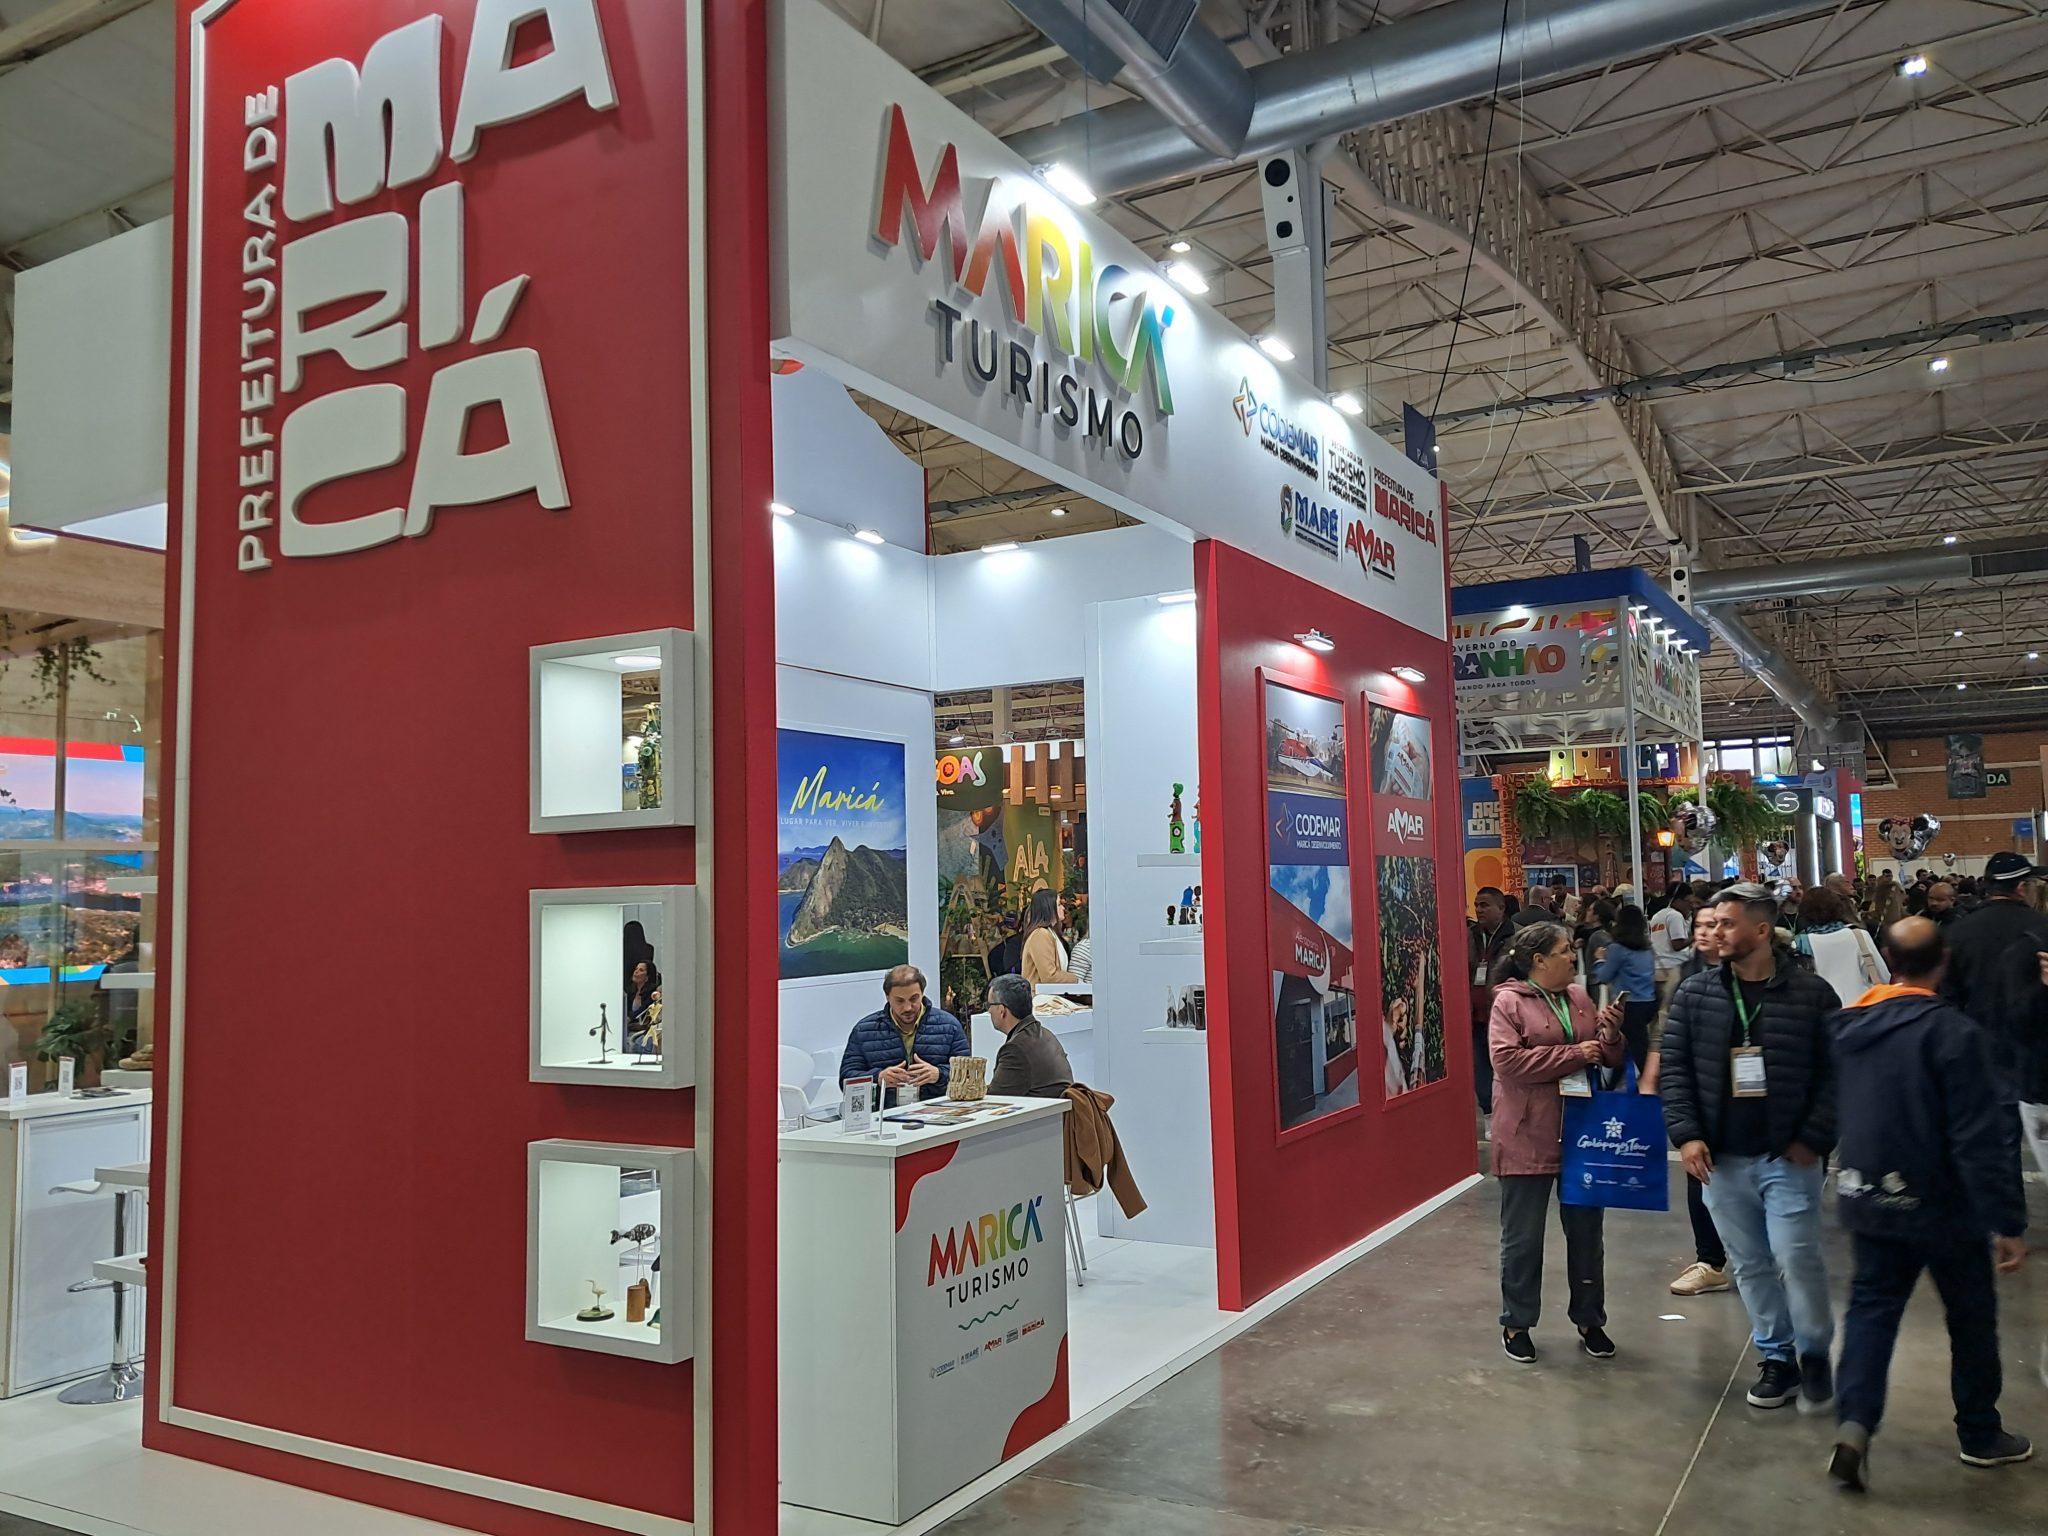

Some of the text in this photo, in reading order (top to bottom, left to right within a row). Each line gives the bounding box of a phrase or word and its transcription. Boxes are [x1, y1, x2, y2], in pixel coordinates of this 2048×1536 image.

[238, 84, 279, 572] PREFEITURA DE
[928, 298, 1144, 460] TURISMO
[1260, 402, 1319, 467] CODEMAR
[1328, 448, 1367, 490] TURISMO
[1373, 467, 1415, 505] PREFEITURA DE
[1295, 490, 1339, 542] MARÉ
[1374, 482, 1436, 548] MARICÁ
[1344, 519, 1395, 572] AMAR
[1452, 639, 1517, 653] OVERNO DO
[1453, 642, 1566, 681] RANHÃO
[1456, 679, 1536, 692] HANDO PARA TODOS
[789, 765, 885, 815] Maricá
[1986, 773, 2008, 785] DA
[780, 817, 803, 825] LUGAR
[805, 818, 823, 826] PARA
[1295, 813, 1341, 838] CODEMAR
[1387, 807, 1424, 845] AMAR
[1012, 833, 1049, 883] ALA
[927, 1195, 1044, 1287] MARICÁ
[946, 1257, 1029, 1309] TURISMO
